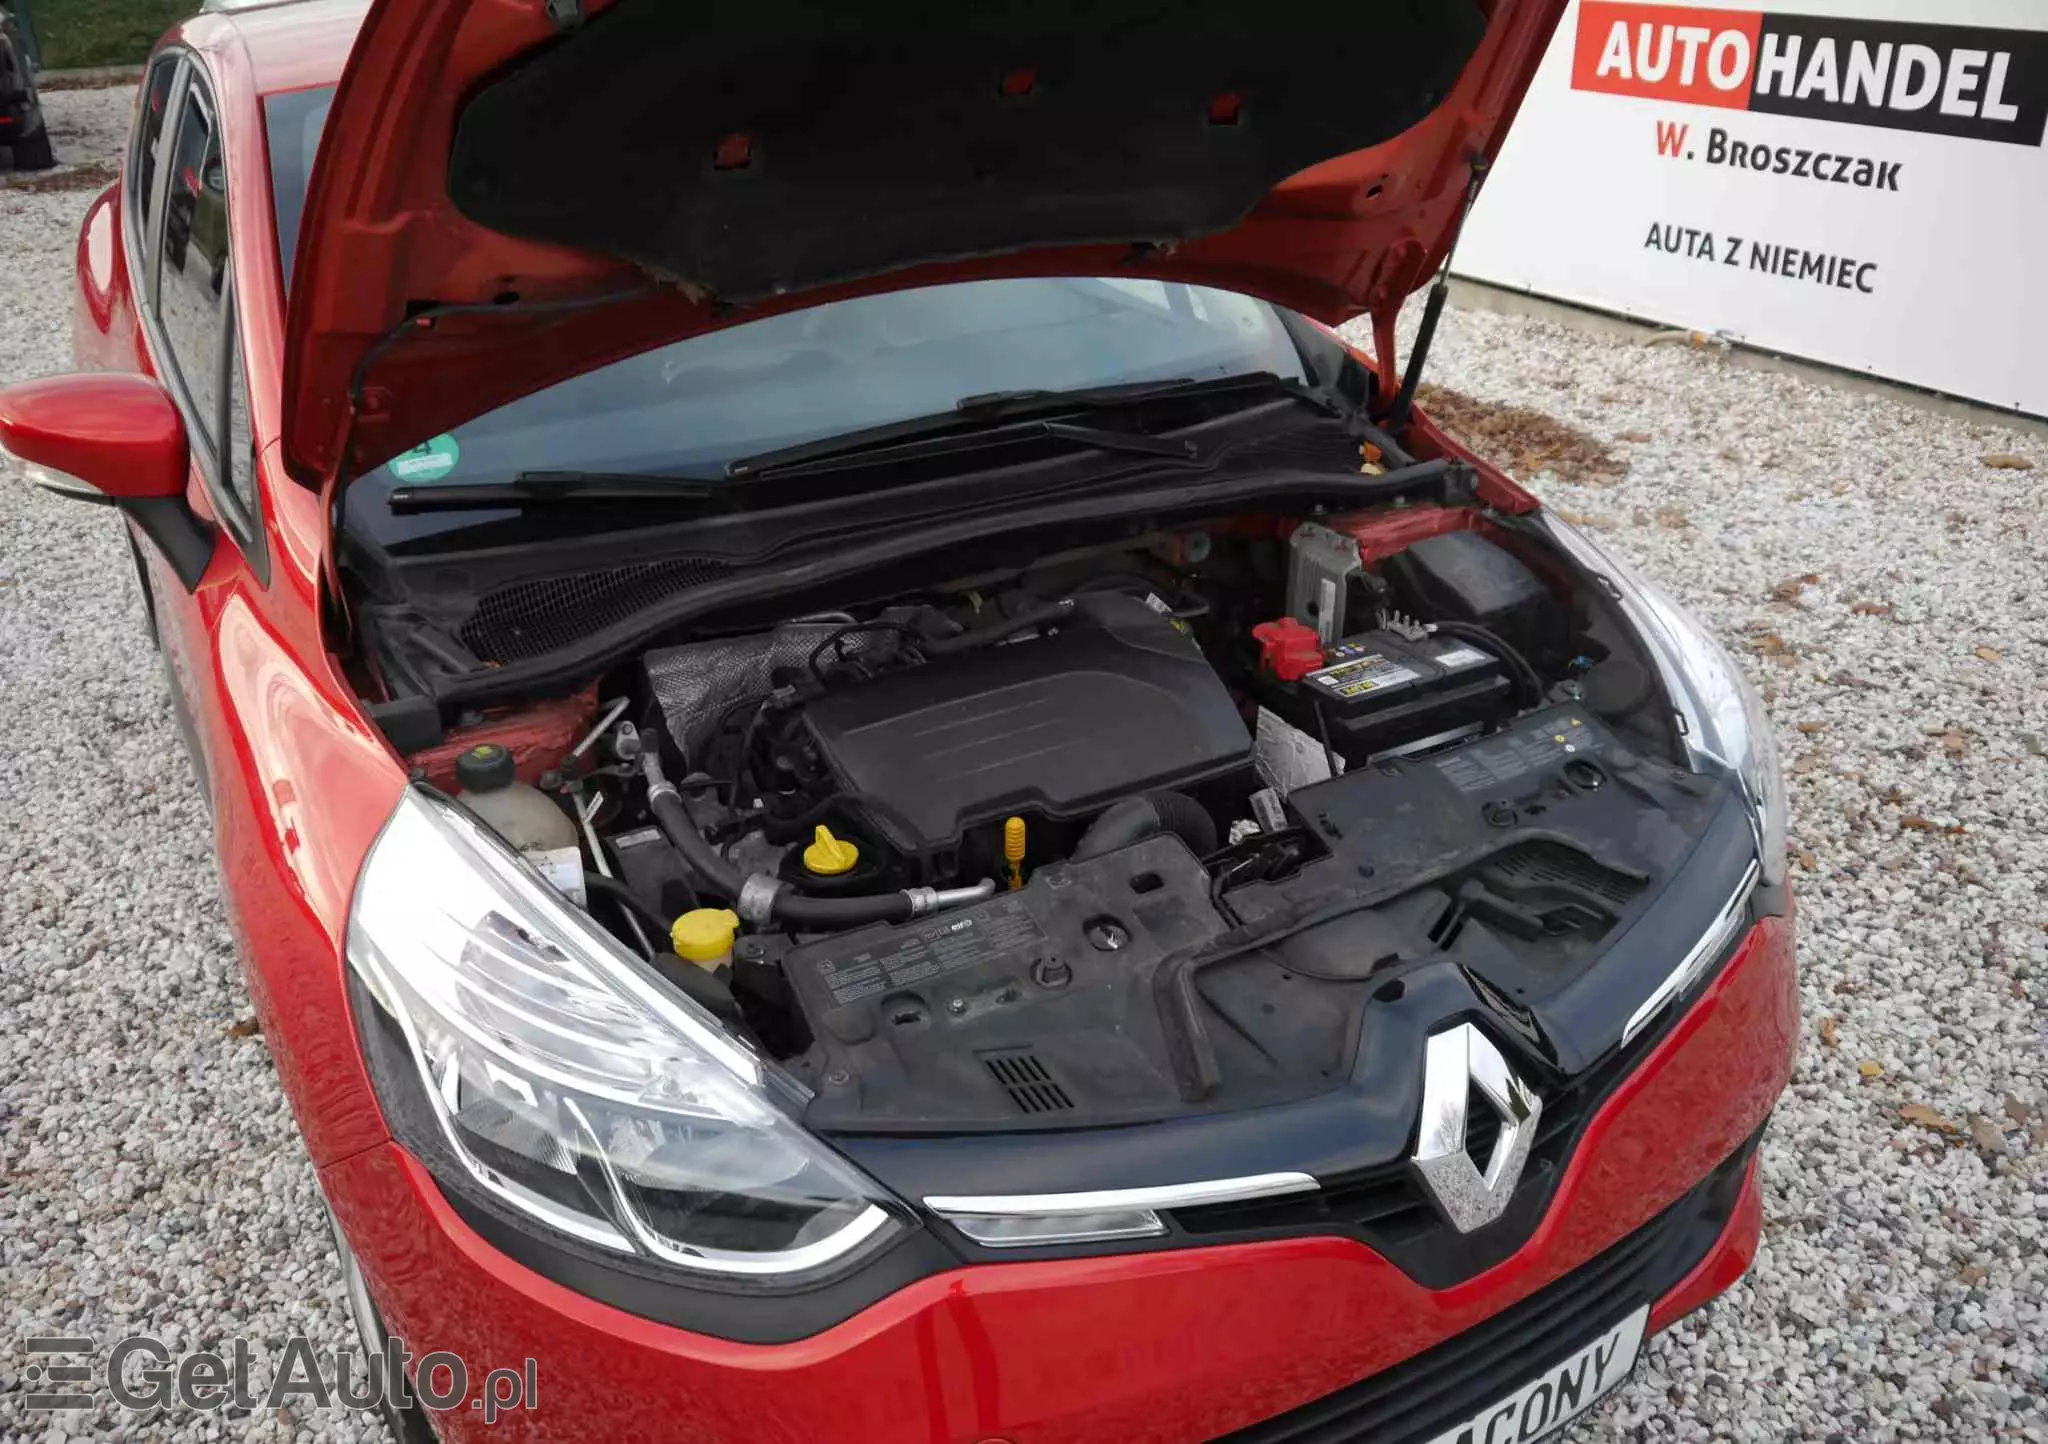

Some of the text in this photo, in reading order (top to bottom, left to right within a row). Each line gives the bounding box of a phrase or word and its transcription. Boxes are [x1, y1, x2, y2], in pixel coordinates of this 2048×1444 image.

[1656, 120, 1694, 160] W.
[1644, 221, 1878, 294] AUTA Z NIEMIEC
[1455, 1330, 1621, 1444] CONY
